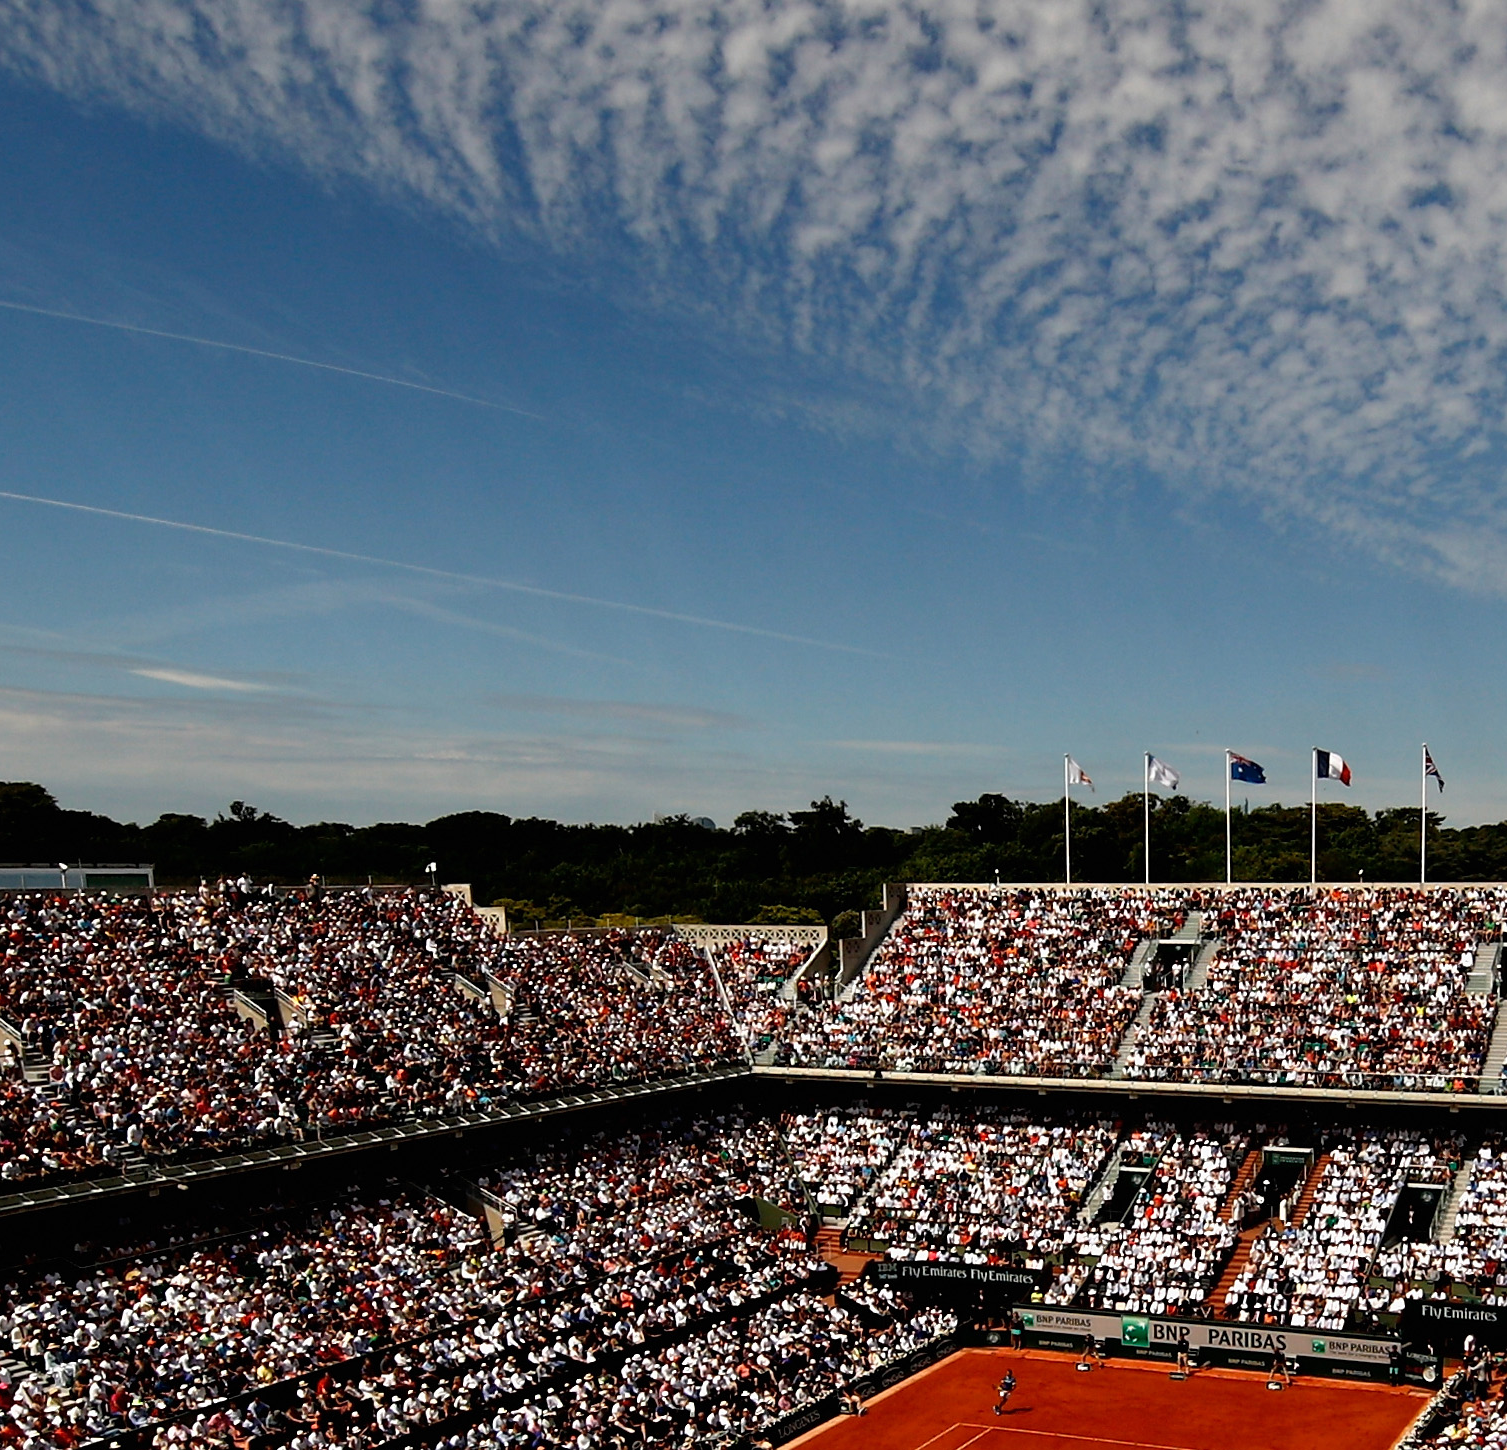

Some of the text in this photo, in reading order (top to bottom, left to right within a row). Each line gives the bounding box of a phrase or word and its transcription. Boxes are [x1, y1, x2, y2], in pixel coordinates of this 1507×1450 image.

[877, 1262, 897, 1272] IBM
[902, 1266, 921, 1278] Fly
[922, 1265, 967, 1279] Emirates
[970, 1268, 1034, 1284] Fly Emirates
[1422, 1305, 1498, 1322] Fly Emirates
[1036, 1314, 1054, 1324] BNP
[1055, 1316, 1091, 1328] PARIBAS
[1051, 1340, 1073, 1348] PARIBAS
[1153, 1324, 1287, 1350] BNP PARIBAS
[1148, 1350, 1172, 1358] PARIBAS
[1329, 1341, 1349, 1351] BNP
[1350, 1343, 1391, 1355] PARIBAS
[1242, 1359, 1266, 1367] PARIBAS
[1346, 1369, 1371, 1378] PARIBAS
[777, 1409, 821, 1439] LONGINES
